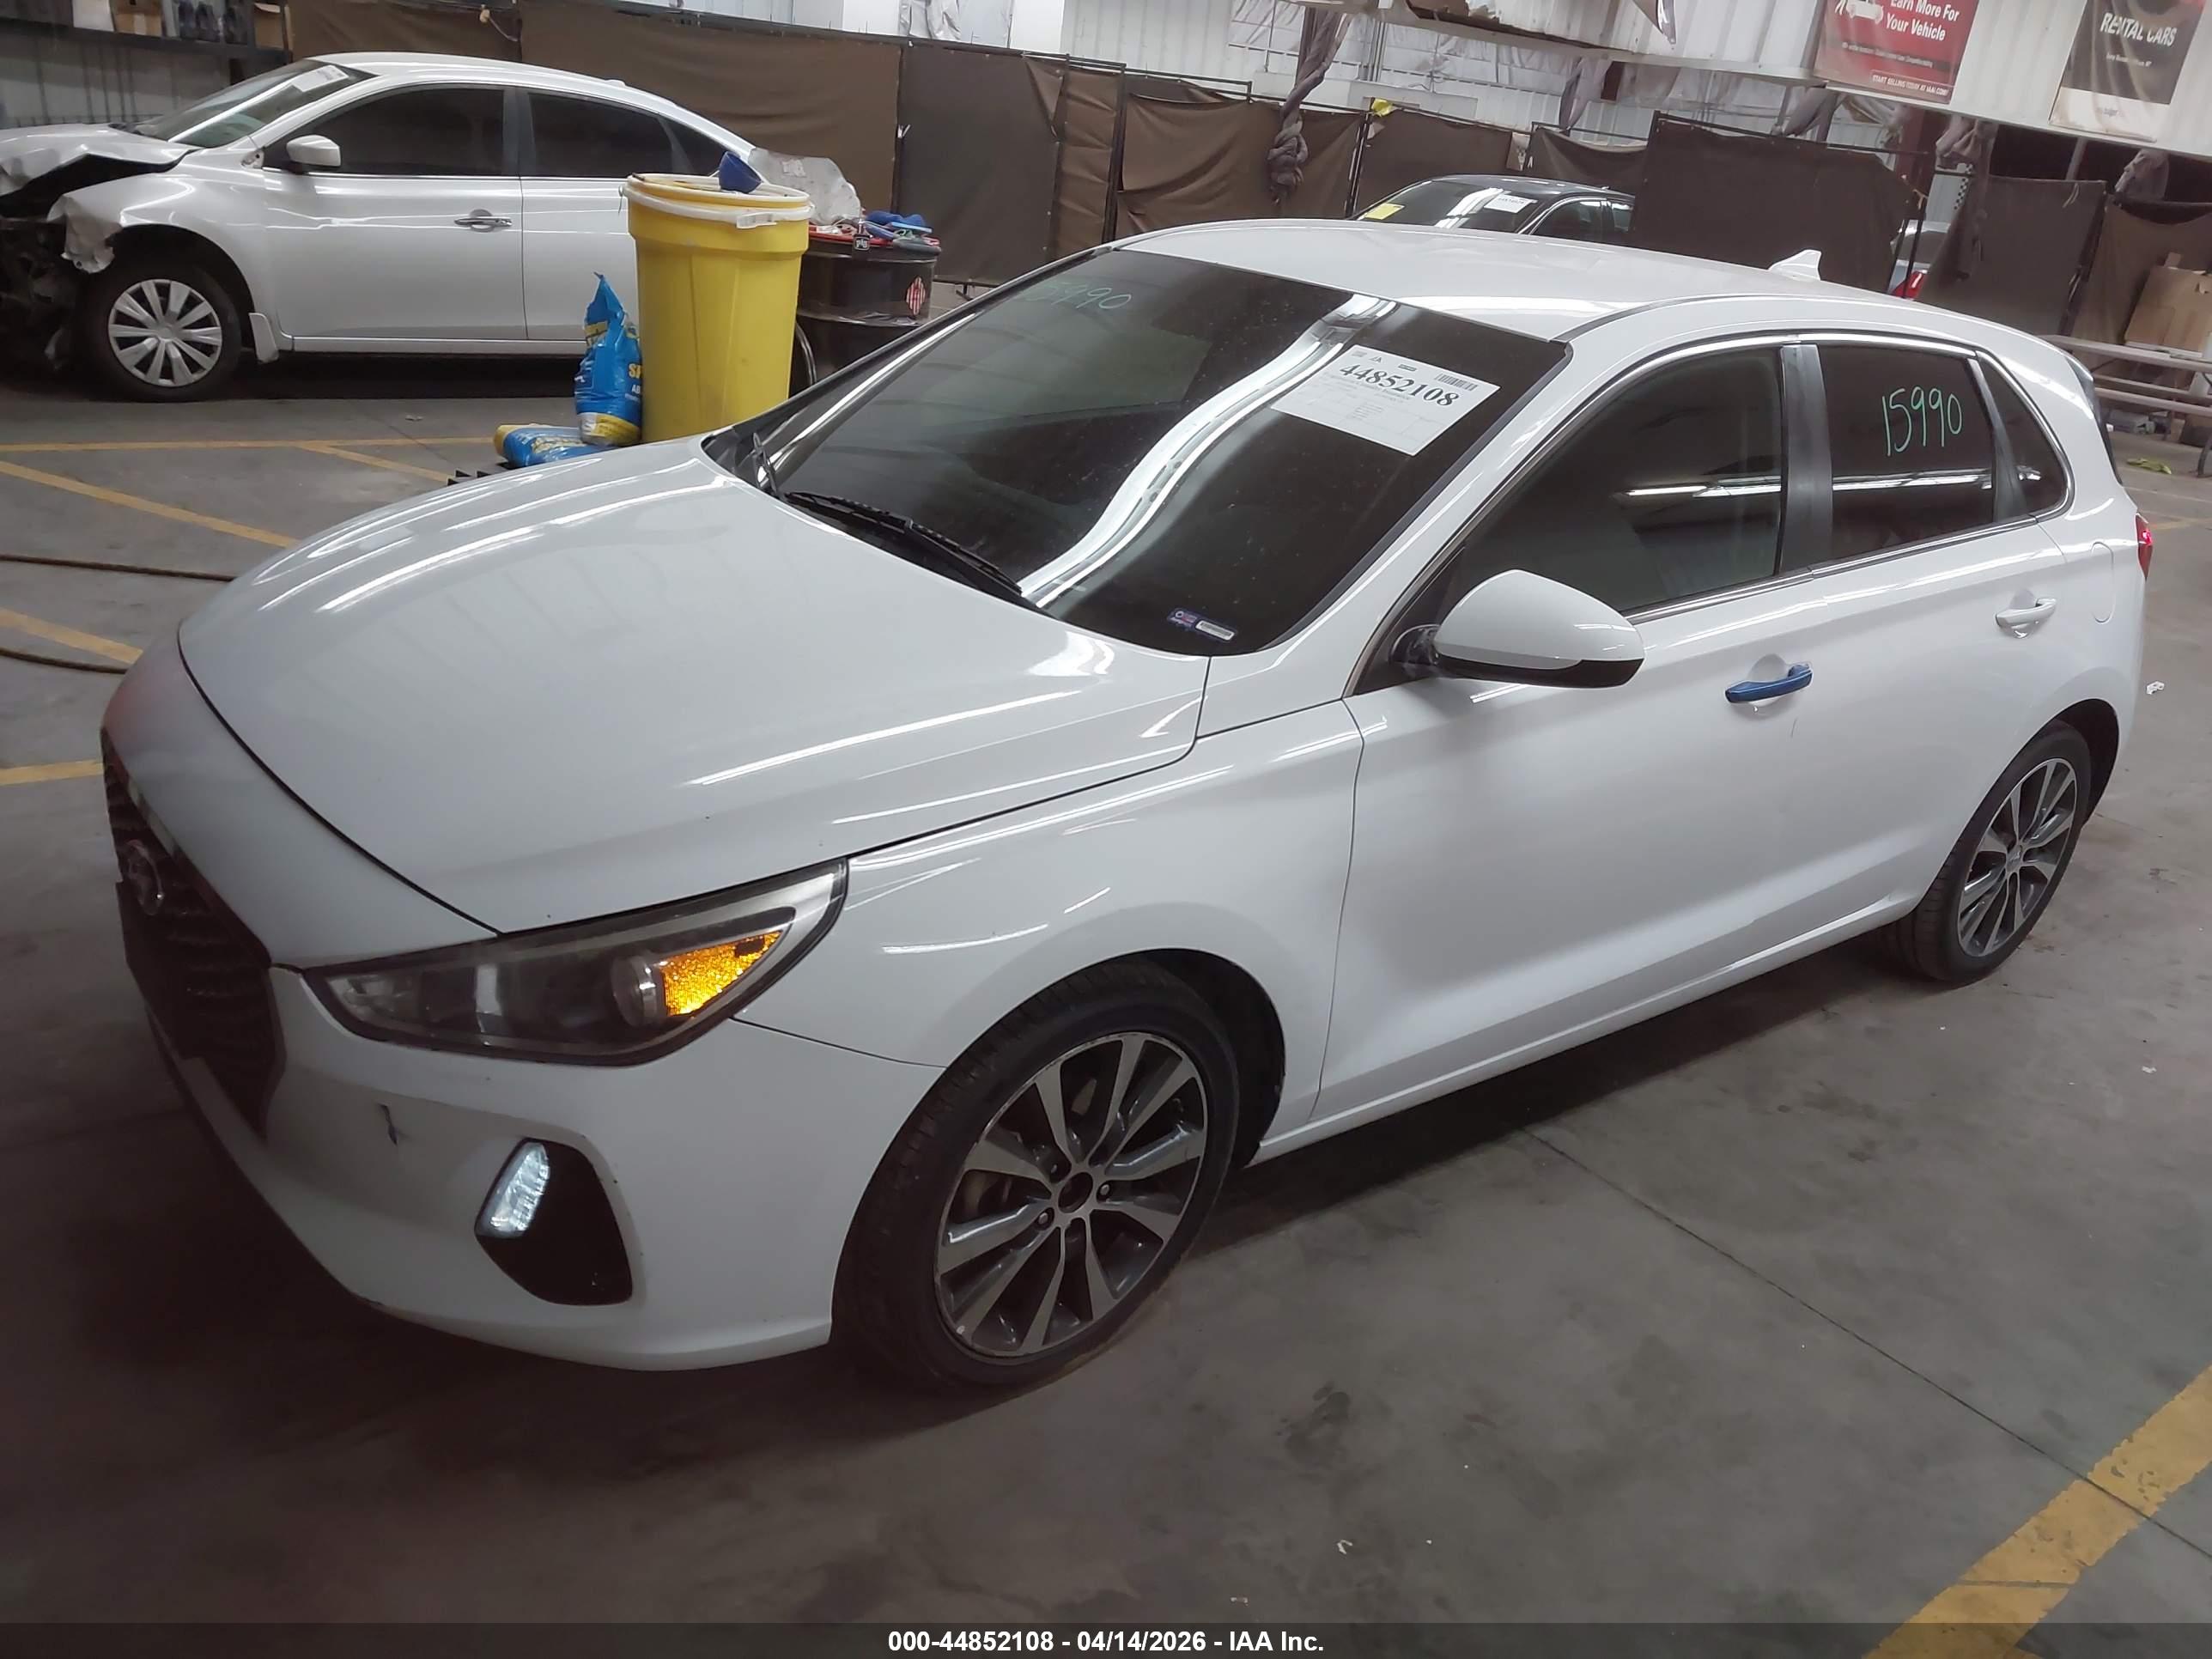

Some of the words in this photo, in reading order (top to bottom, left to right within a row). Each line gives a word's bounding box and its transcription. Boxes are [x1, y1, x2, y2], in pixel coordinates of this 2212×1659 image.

[1887, 12, 1909, 33] Your
[1911, 18, 1946, 41] Vehicle
[1916, 0, 1942, 17] More
[1942, 4, 1960, 21] For
[2100, 12, 2143, 40] RENTAL
[2147, 26, 2178, 46] CARS
[1340, 364, 1460, 406] 44852108
[1882, 386, 1962, 456] 15990
